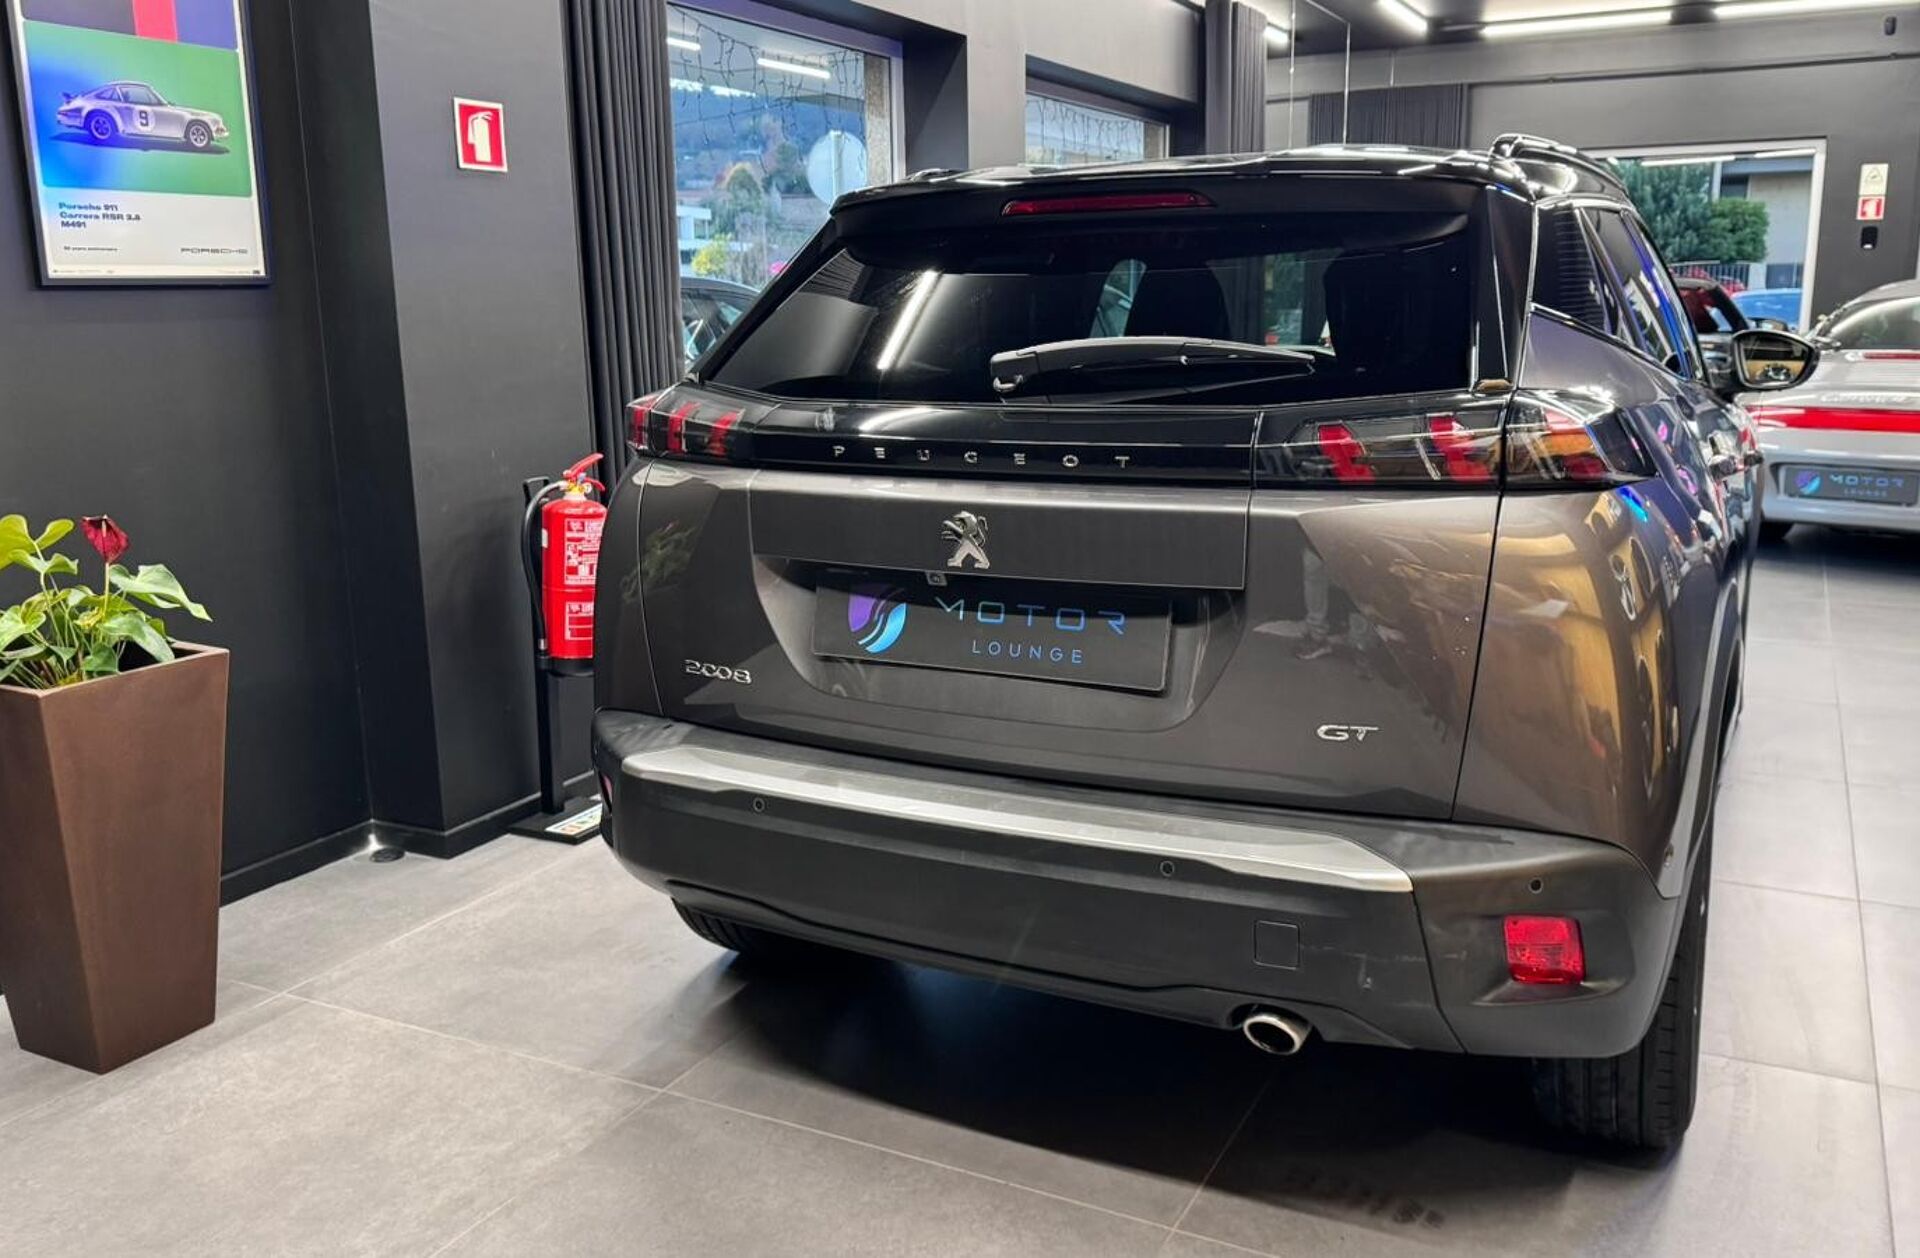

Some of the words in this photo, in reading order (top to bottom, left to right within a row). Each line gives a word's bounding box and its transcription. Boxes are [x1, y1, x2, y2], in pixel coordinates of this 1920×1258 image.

[139, 110, 149, 127] 9
[58, 202, 101, 210] Porsche
[103, 203, 118, 211] 911
[60, 211, 100, 219] Carrera
[832, 445, 1130, 469] PEUGEOT
[1829, 473, 1904, 489] MOTOR
[935, 595, 1125, 635] MOTOR
[972, 639, 1083, 664] LOUNGE
[684, 659, 752, 684] 2008
[1317, 714, 1379, 741] GT
